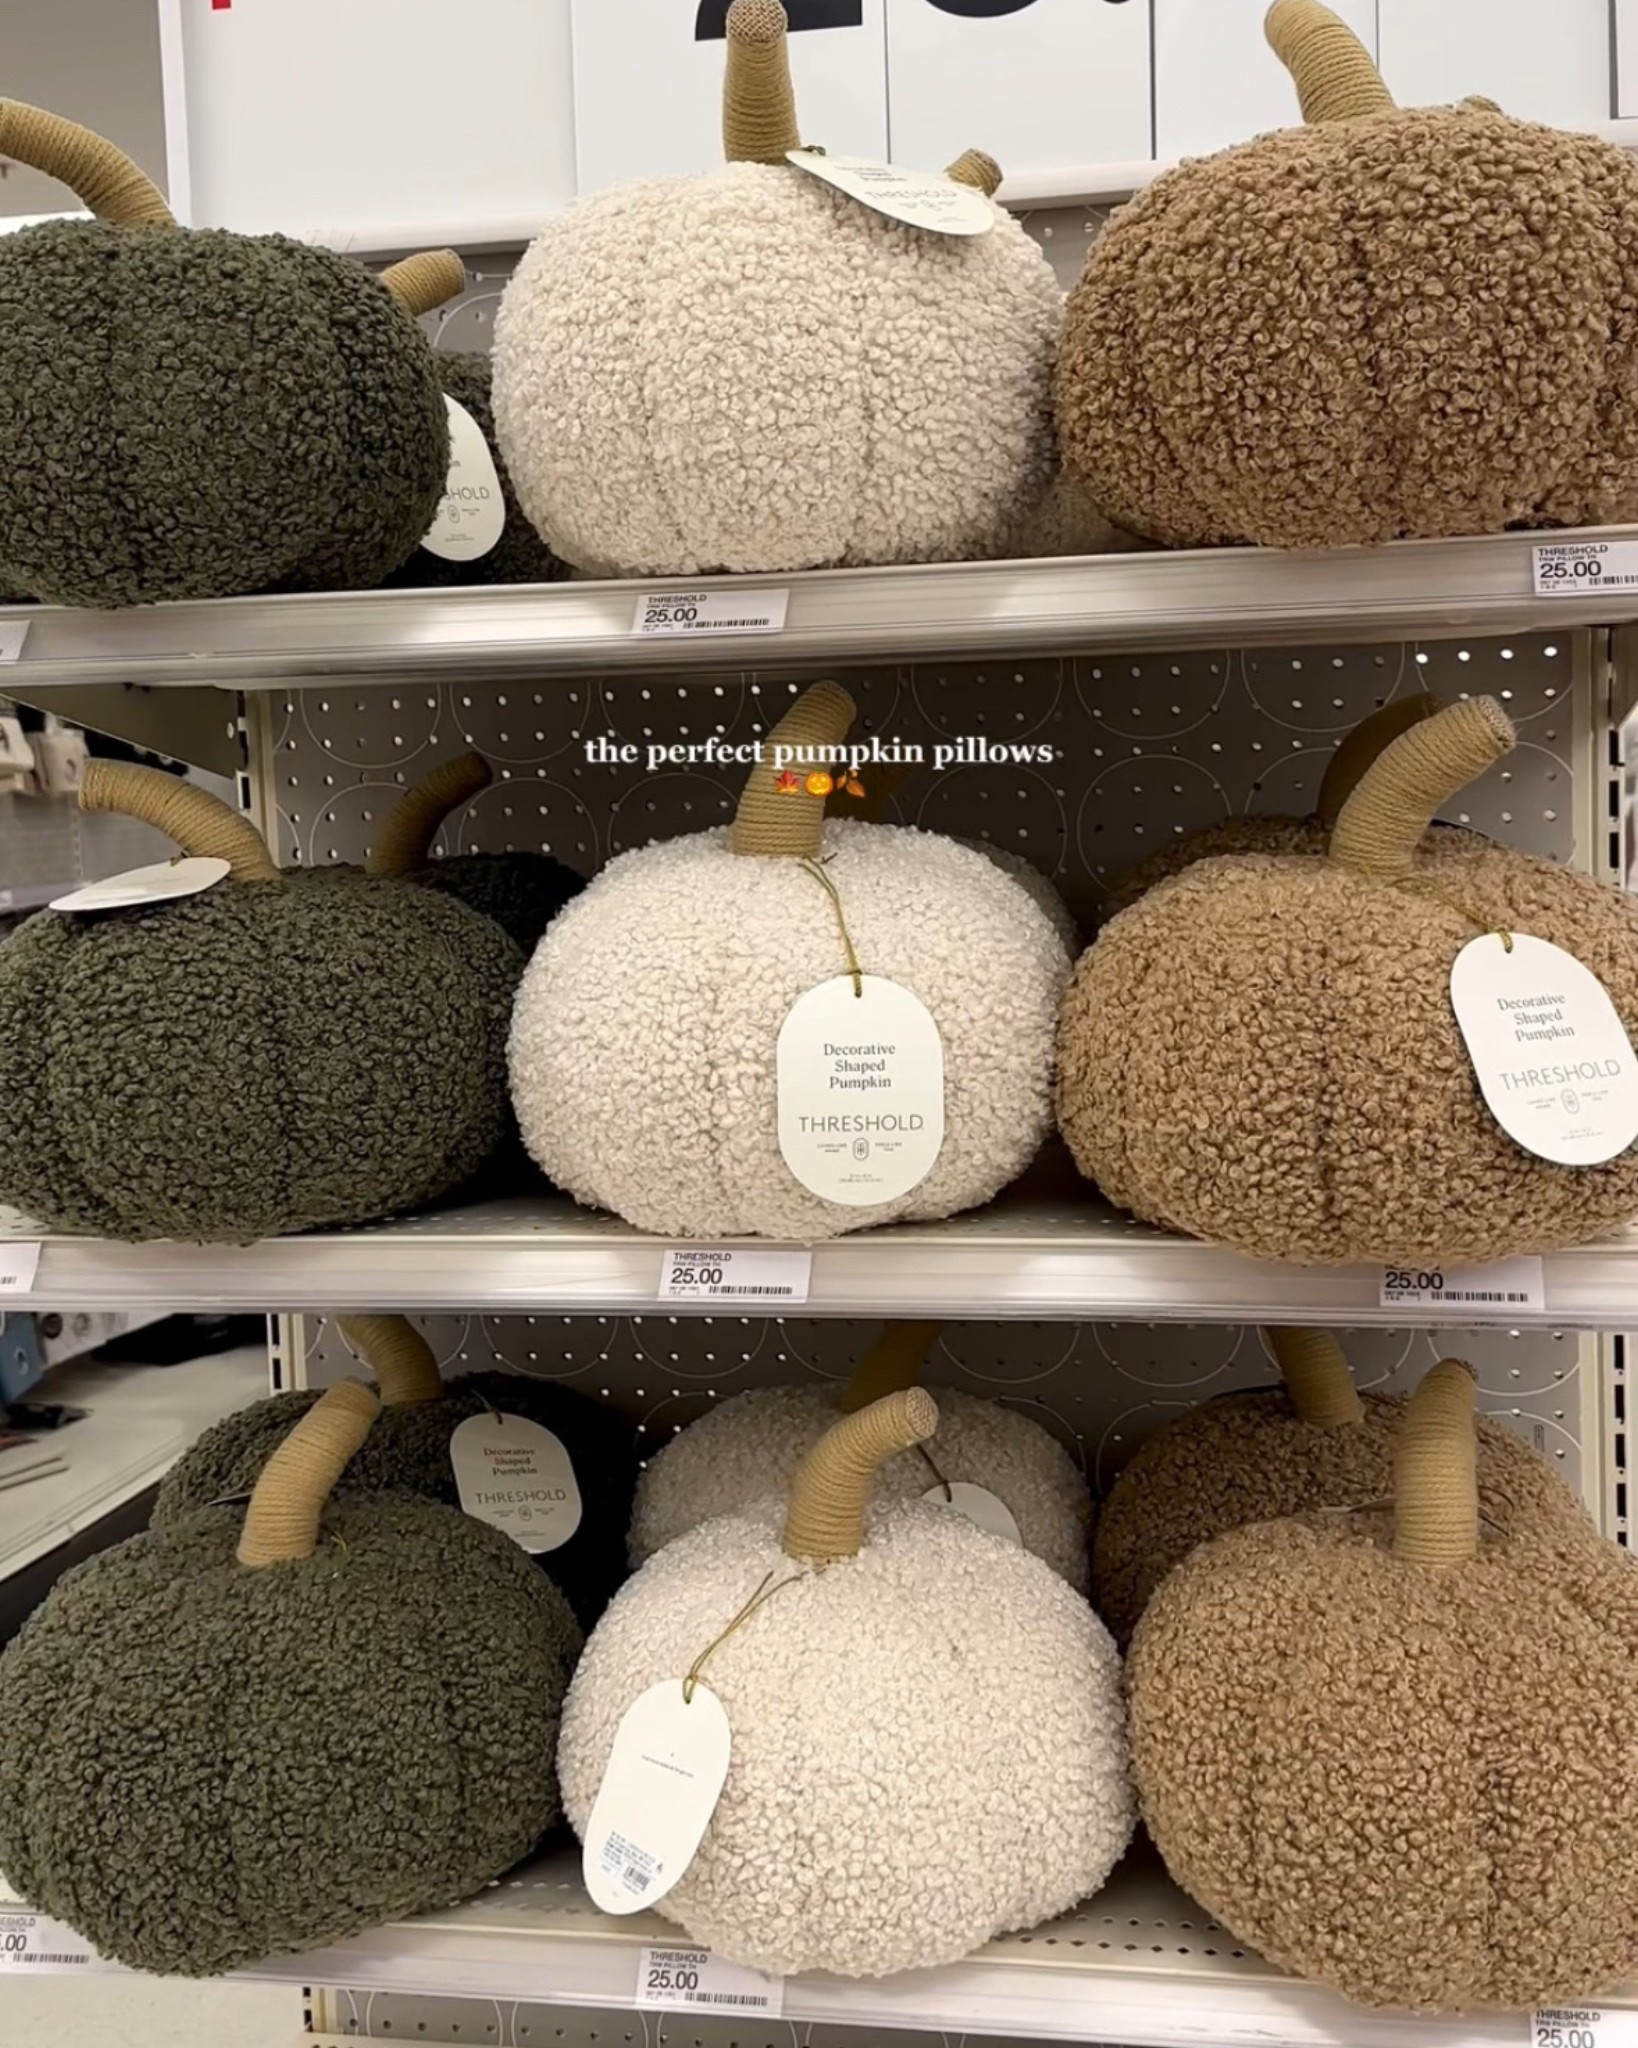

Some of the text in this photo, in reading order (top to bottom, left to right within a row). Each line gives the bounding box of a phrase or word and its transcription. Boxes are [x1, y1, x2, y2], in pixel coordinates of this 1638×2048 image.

[1538, 544, 1608, 556] THRESHOLD
[1540, 560, 1602, 578] 25.00
[648, 594, 707, 604] THRESHOLD
[645, 608, 697, 623] 25.00
[1497, 994, 1566, 1011] Decorative
[1513, 1009, 1563, 1026] Shaped
[1514, 1025, 1575, 1042] Pumpkin
[823, 1043, 896, 1056] Decorative
[834, 1059, 886, 1074] Shaped
[1500, 1059, 1621, 1090] THRESHOLD
[829, 1076, 892, 1091] Pumpkin
[799, 1113, 924, 1132] THRESHOLD
[674, 1252, 732, 1262] THRESHOLD
[671, 1268, 723, 1284] 25.00
[1385, 1272, 1443, 1290] 25.00
[492, 1467, 538, 1476] Pumpkin
[475, 1489, 567, 1504] THRESHOLD
[0, 1933, 27, 1951] .00
[650, 1951, 708, 1964] THRESHOLD
[647, 1969, 699, 1990] 25.00
[1537, 2028, 1595, 2048] 25.00
